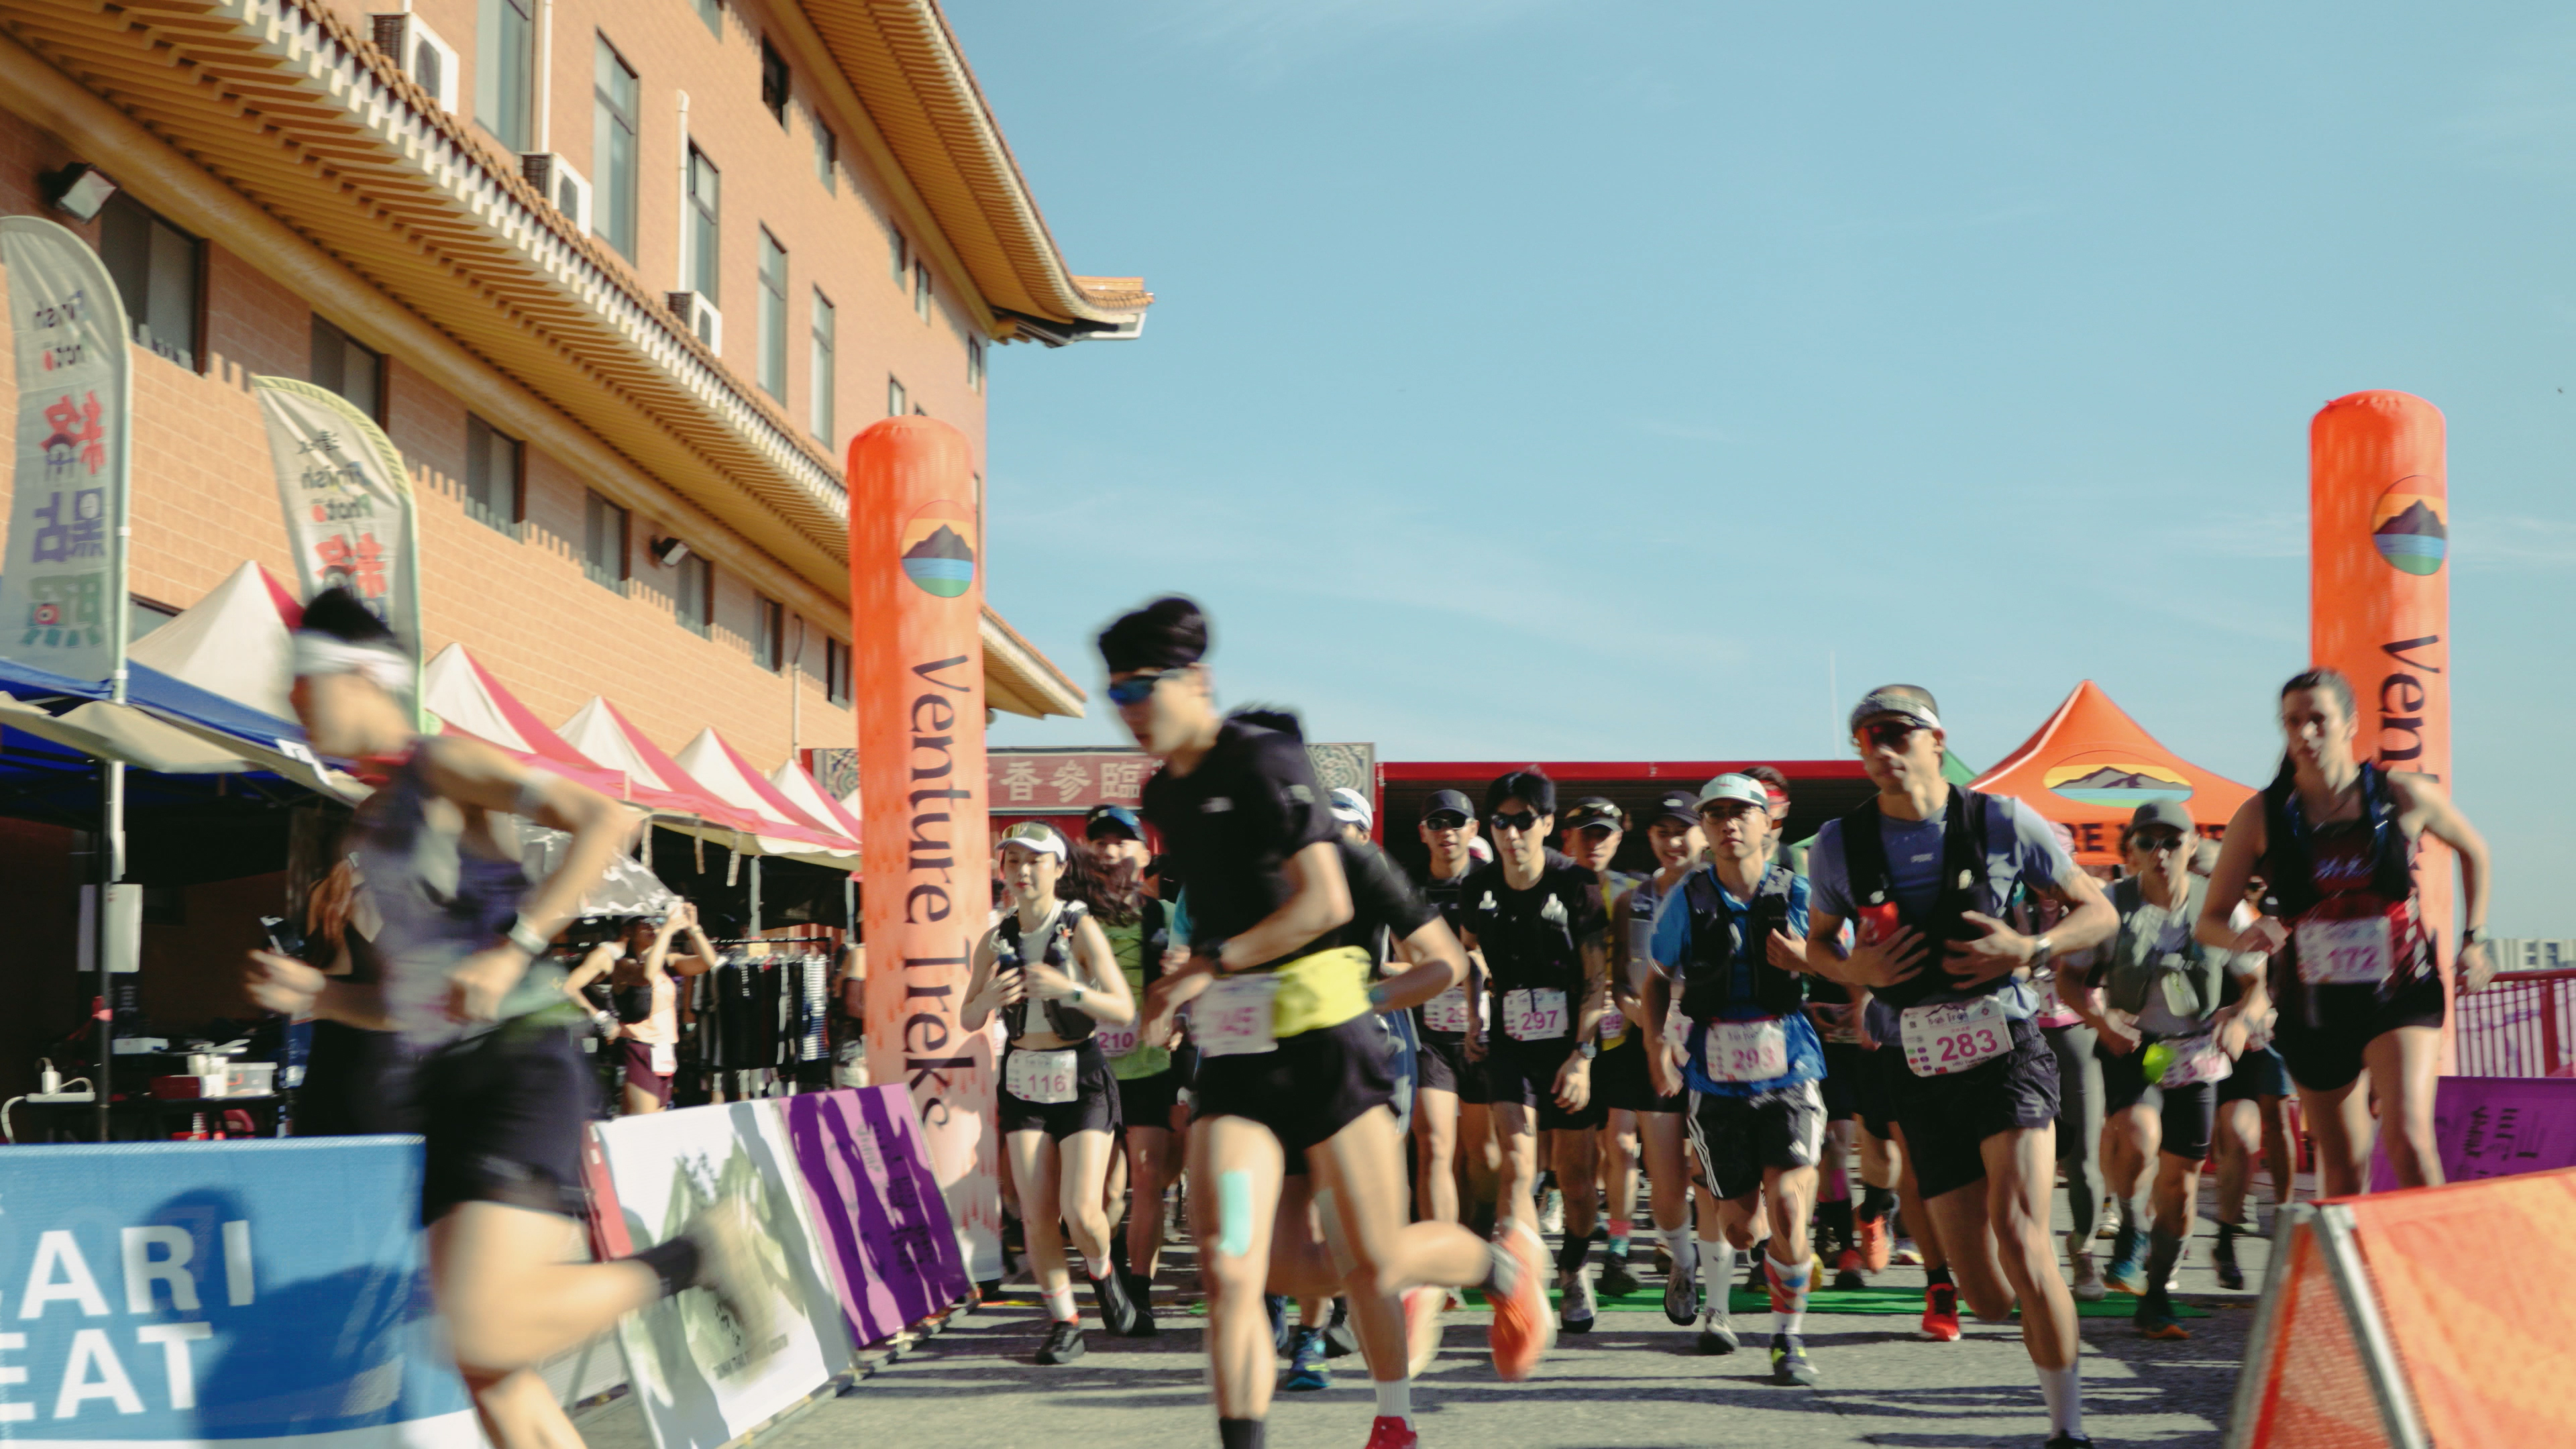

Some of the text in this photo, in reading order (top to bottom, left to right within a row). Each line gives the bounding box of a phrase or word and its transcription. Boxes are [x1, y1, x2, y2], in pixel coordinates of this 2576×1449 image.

[2378, 633, 2440, 786] Ven
[904, 654, 972, 924] Venture
[1520, 1010, 1559, 1031] 297
[1097, 1032, 1135, 1049] 210
[1936, 1029, 1998, 1062] 283
[1028, 1075, 1066, 1093] 116
[0, 1220, 255, 1320] ARI
